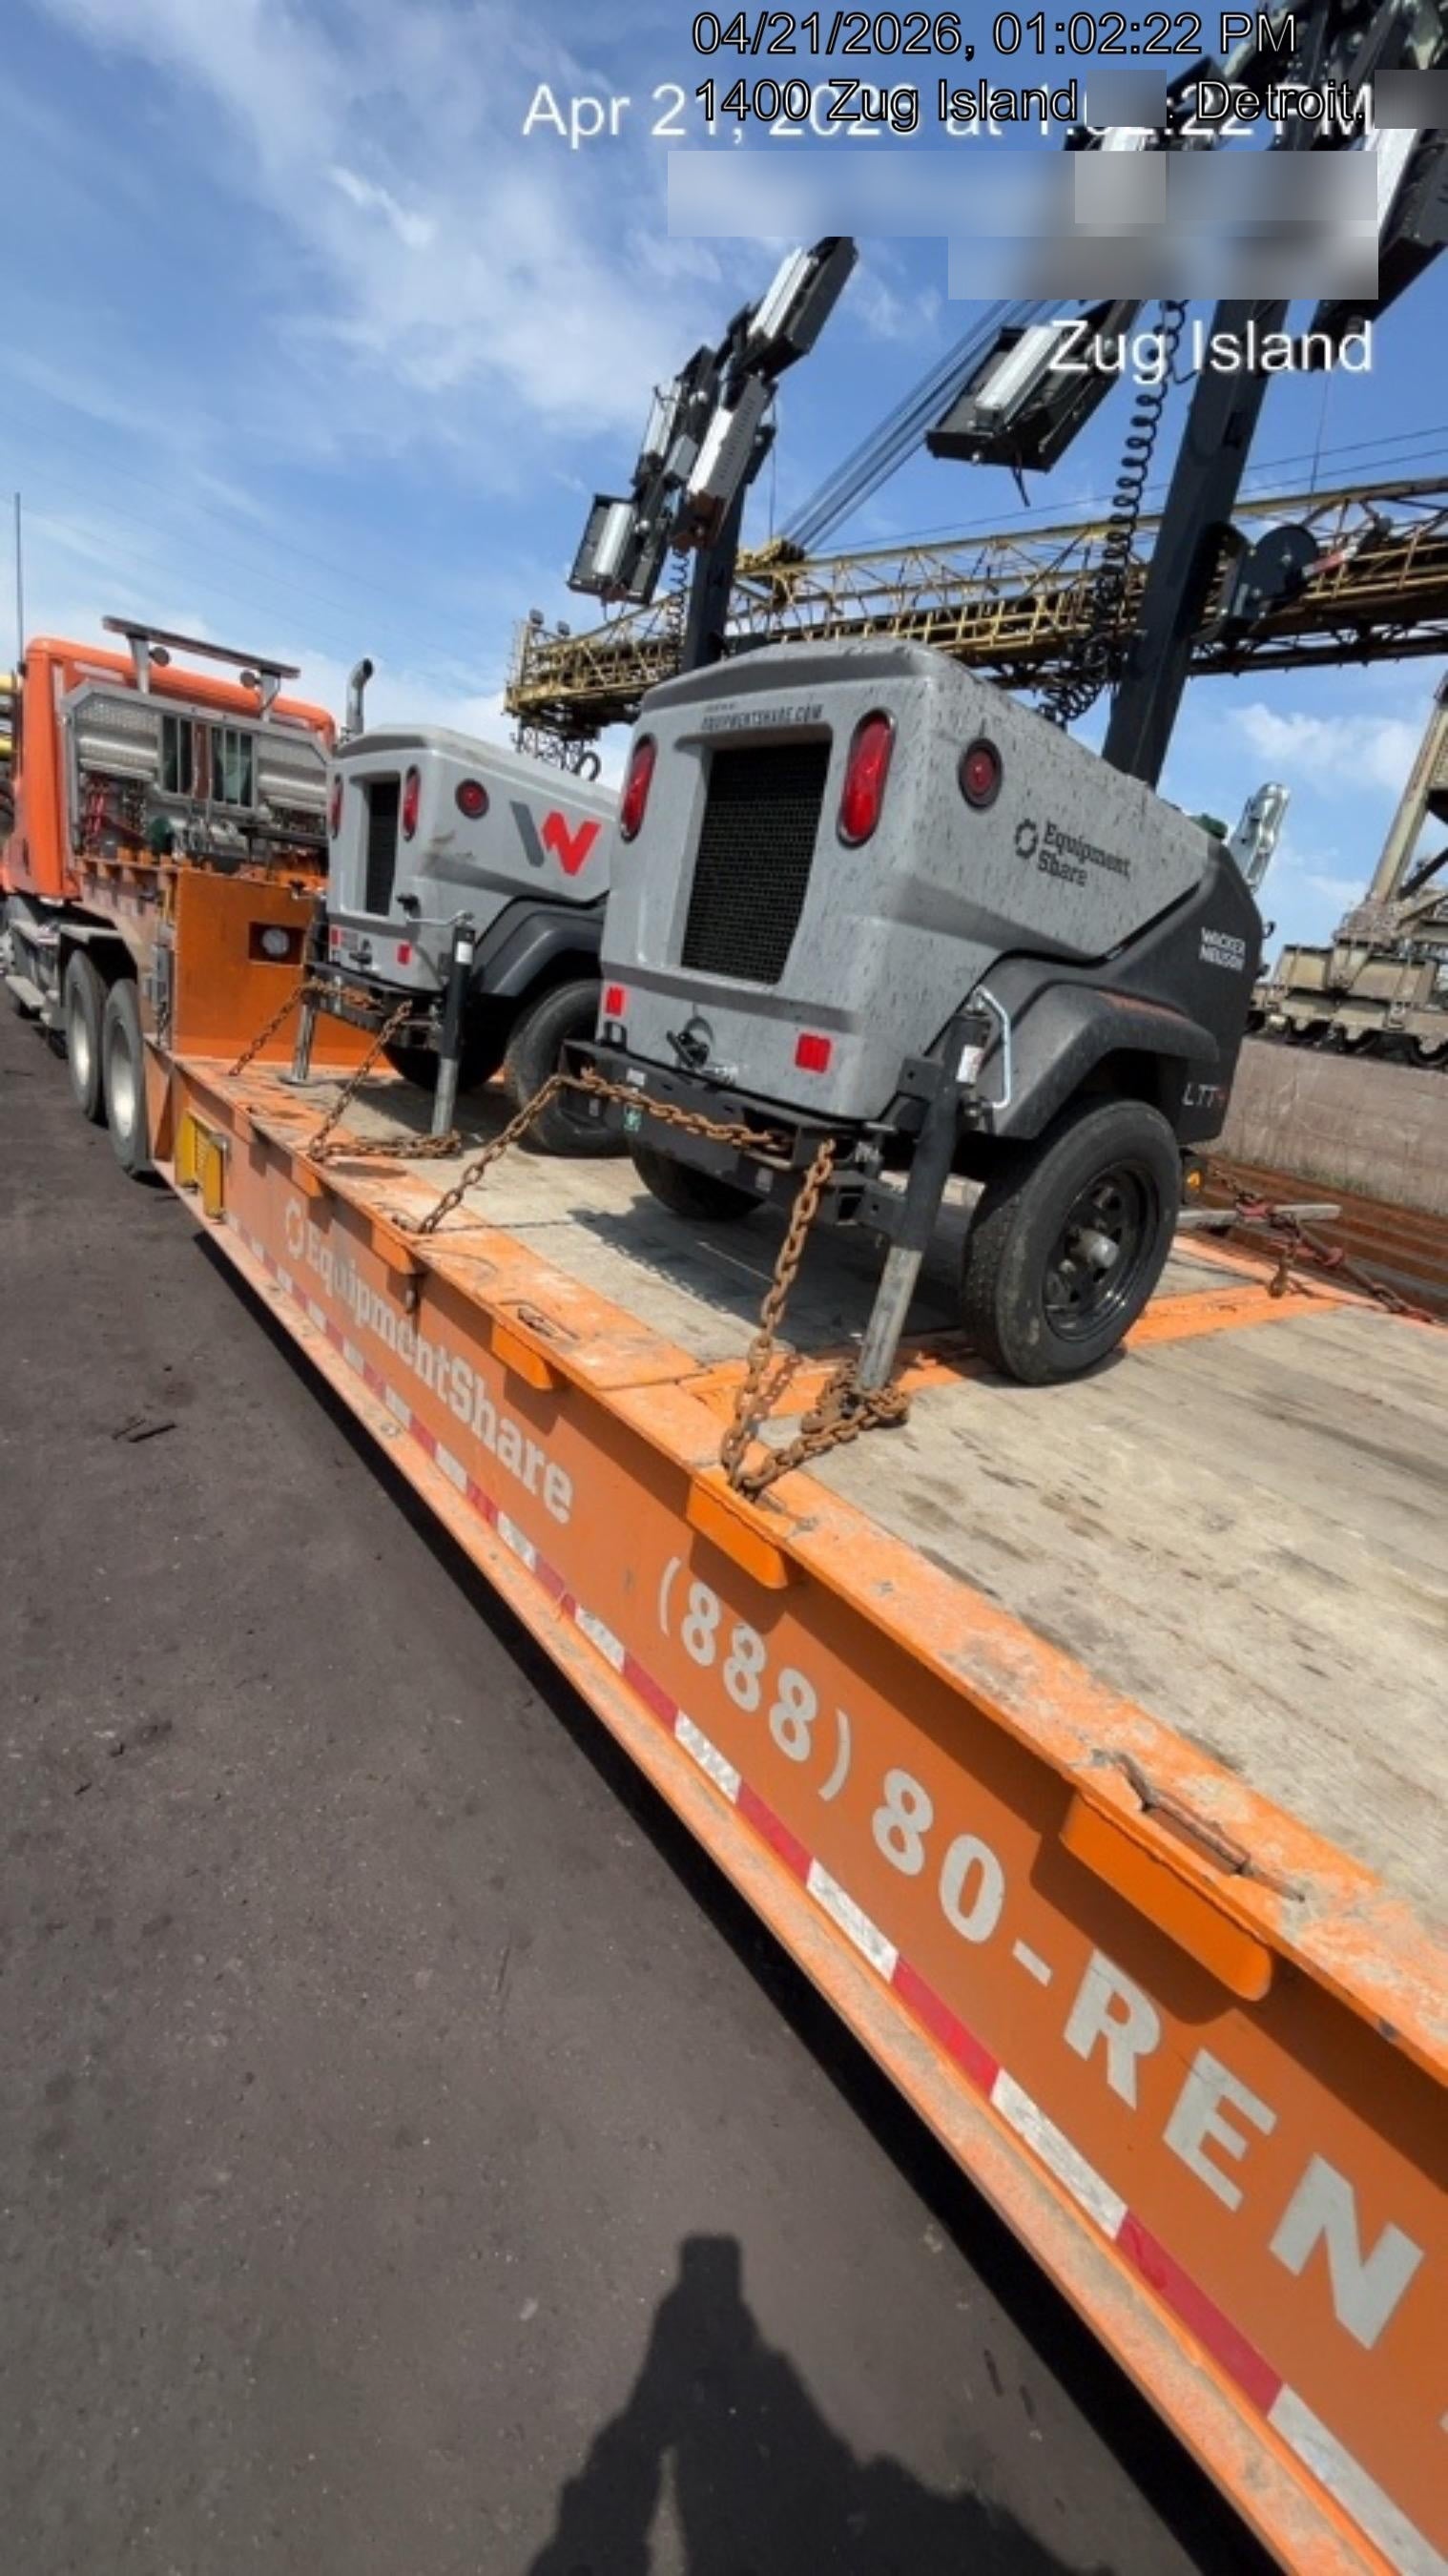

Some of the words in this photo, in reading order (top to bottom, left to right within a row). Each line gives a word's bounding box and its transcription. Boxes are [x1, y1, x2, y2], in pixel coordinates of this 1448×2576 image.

[1037, 849, 1087, 887] Share
[1044, 819, 1130, 880] Equipment
[306, 1219, 574, 1525] EquipmentShare
[658, 1556, 852, 1802] (888)
[871, 1767, 1448, 2435] 80-REN
